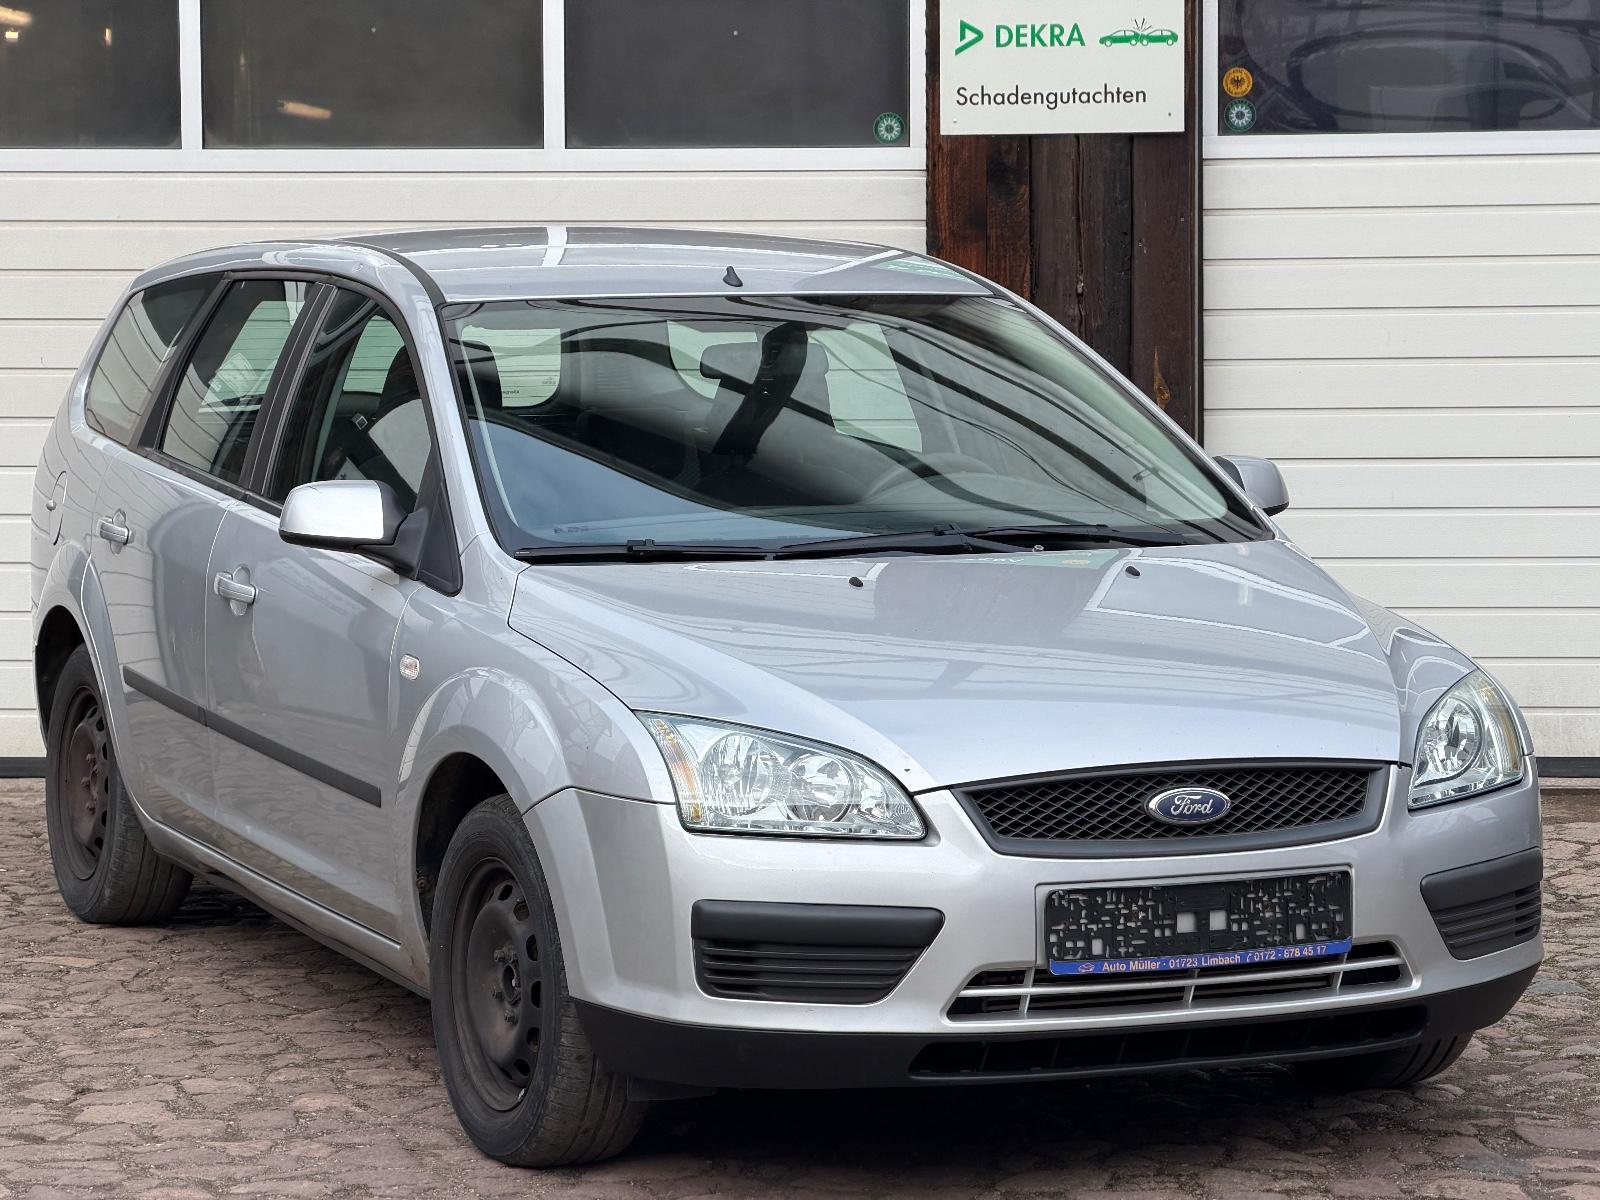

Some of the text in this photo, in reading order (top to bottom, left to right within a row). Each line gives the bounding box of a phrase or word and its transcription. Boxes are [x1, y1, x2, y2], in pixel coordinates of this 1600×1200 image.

[995, 22, 1086, 48] DEKRA
[956, 83, 1147, 110] Schadengutachten
[1171, 794, 1214, 815] Ford
[1102, 961, 1126, 972] Auto
[1129, 959, 1160, 969] Müller
[1169, 957, 1198, 968] 01723
[1201, 954, 1241, 967] Limbach
[1316, 945, 1327, 955] 17
